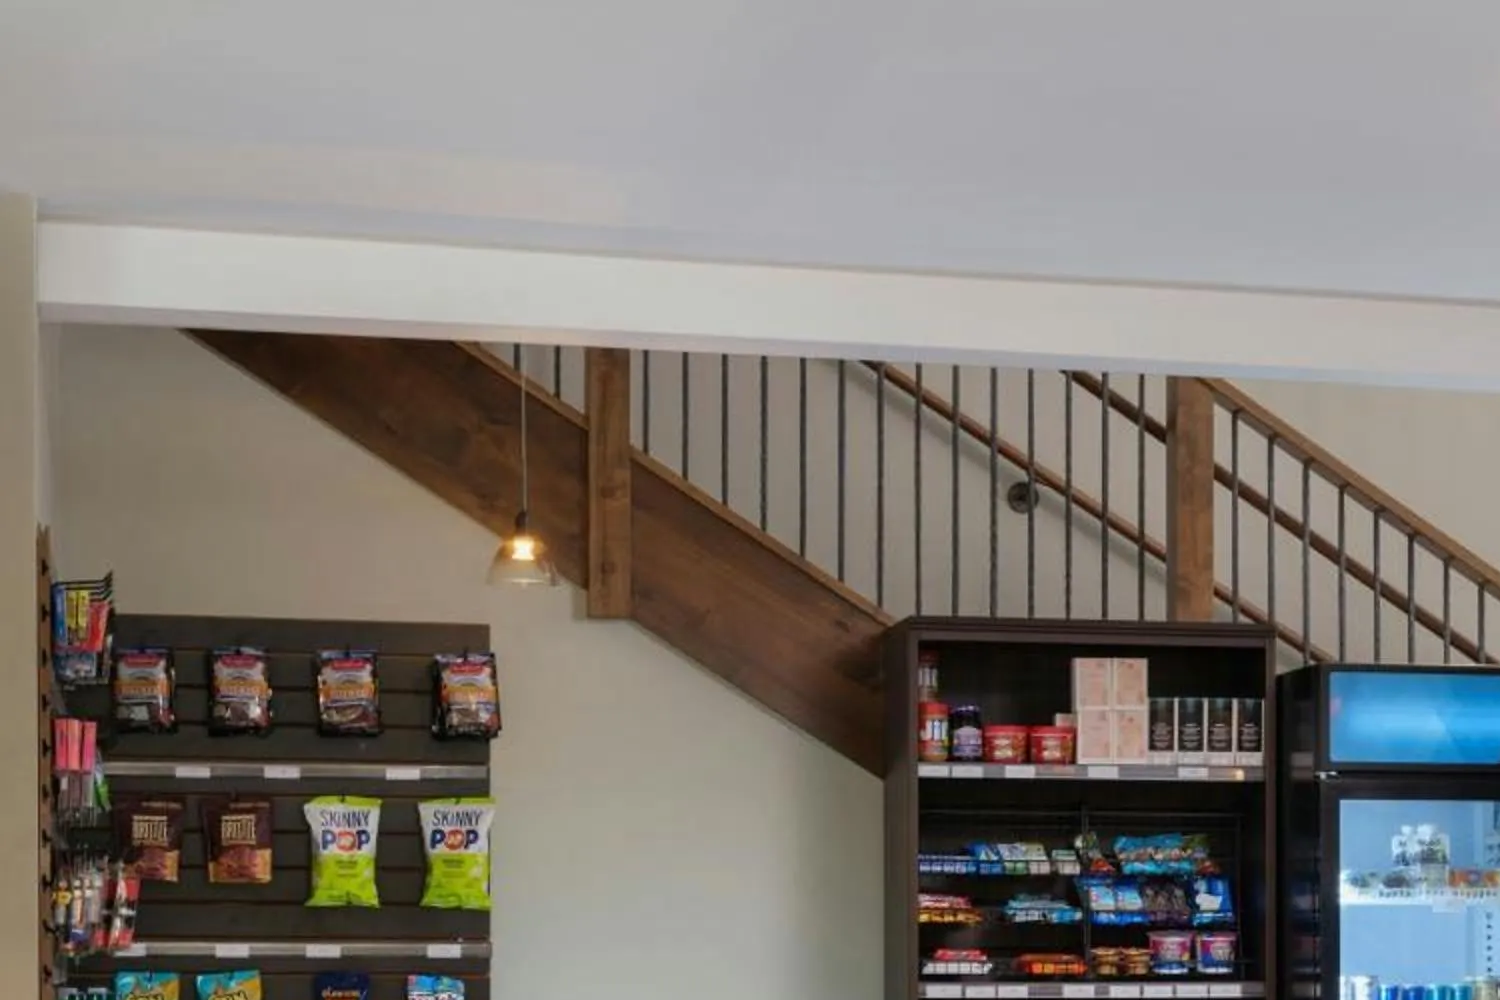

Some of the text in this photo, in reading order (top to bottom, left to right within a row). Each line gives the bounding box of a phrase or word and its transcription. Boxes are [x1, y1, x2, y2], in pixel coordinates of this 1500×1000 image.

[320, 810, 371, 828] SKINNY
[432, 809, 483, 827] SKINNY
[321, 829, 371, 851] POP
[430, 828, 479, 851] POP
